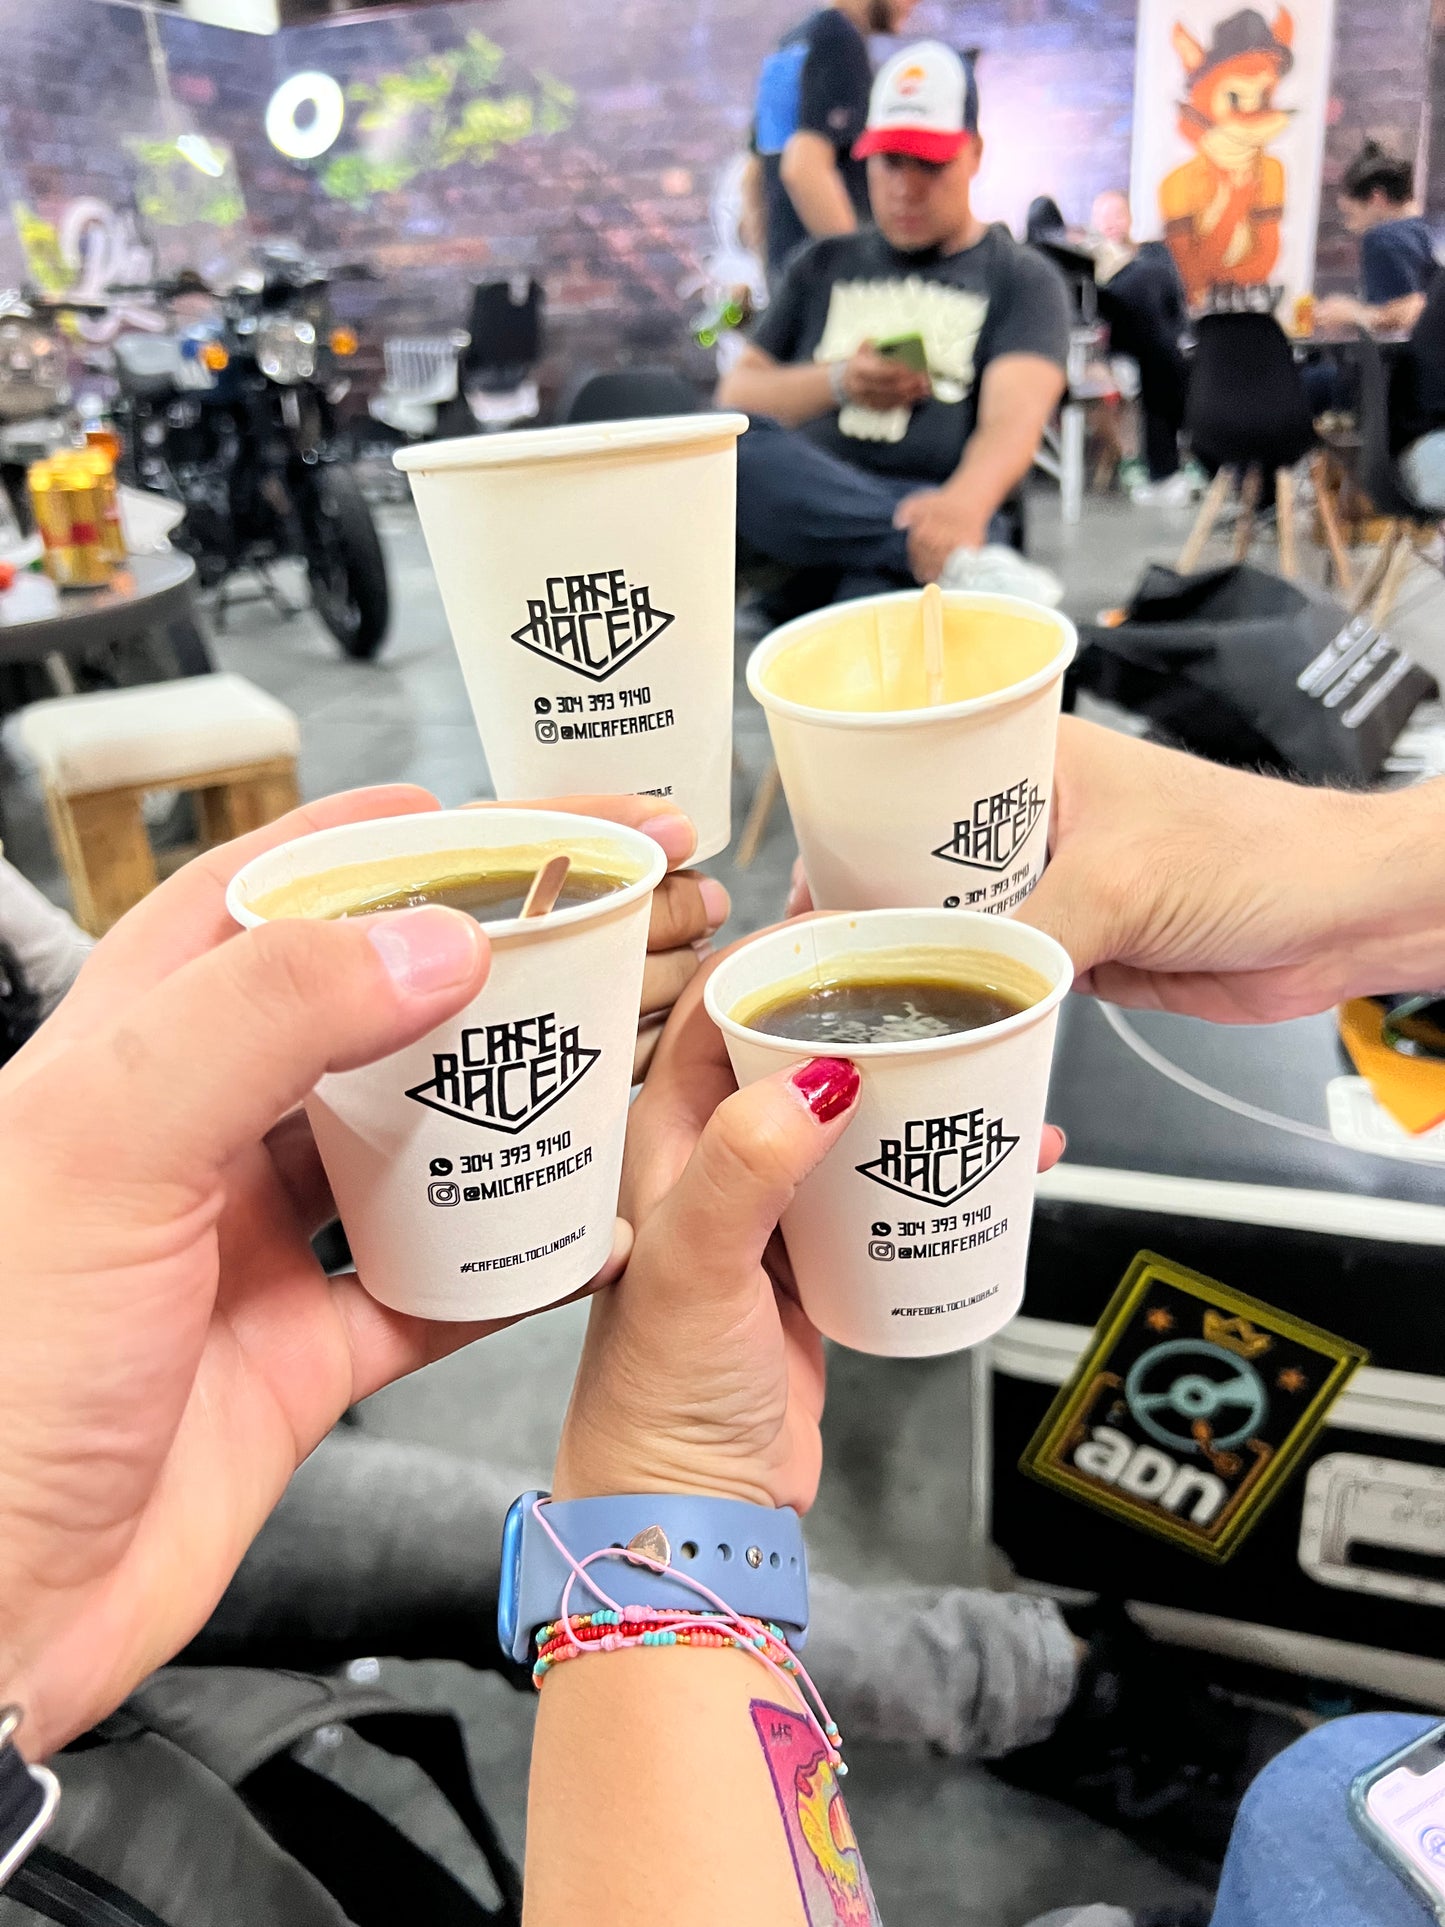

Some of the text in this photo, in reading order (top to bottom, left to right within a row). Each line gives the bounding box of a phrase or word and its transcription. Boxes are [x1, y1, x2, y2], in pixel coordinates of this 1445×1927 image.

[546, 569, 629, 614] CAFE
[526, 586, 653, 670] RACER
[556, 687, 651, 713] 304 393 9140
[560, 709, 675, 740] @MICAFERACER
[953, 784, 1039, 862] RACER
[973, 778, 1028, 829] CAFE
[965, 864, 1030, 906] 304 393 9140
[461, 1012, 557, 1068] CAFE
[432, 1025, 580, 1121] RACER
[460, 1130, 571, 1174] 304 393 9140
[904, 1107, 984, 1152] CAFE
[463, 1146, 593, 1202] @MICAFERACER
[880, 1117, 1004, 1197] RACER
[897, 1205, 992, 1236] 304 393 9140
[898, 1218, 1008, 1259] @MICAFERACER
